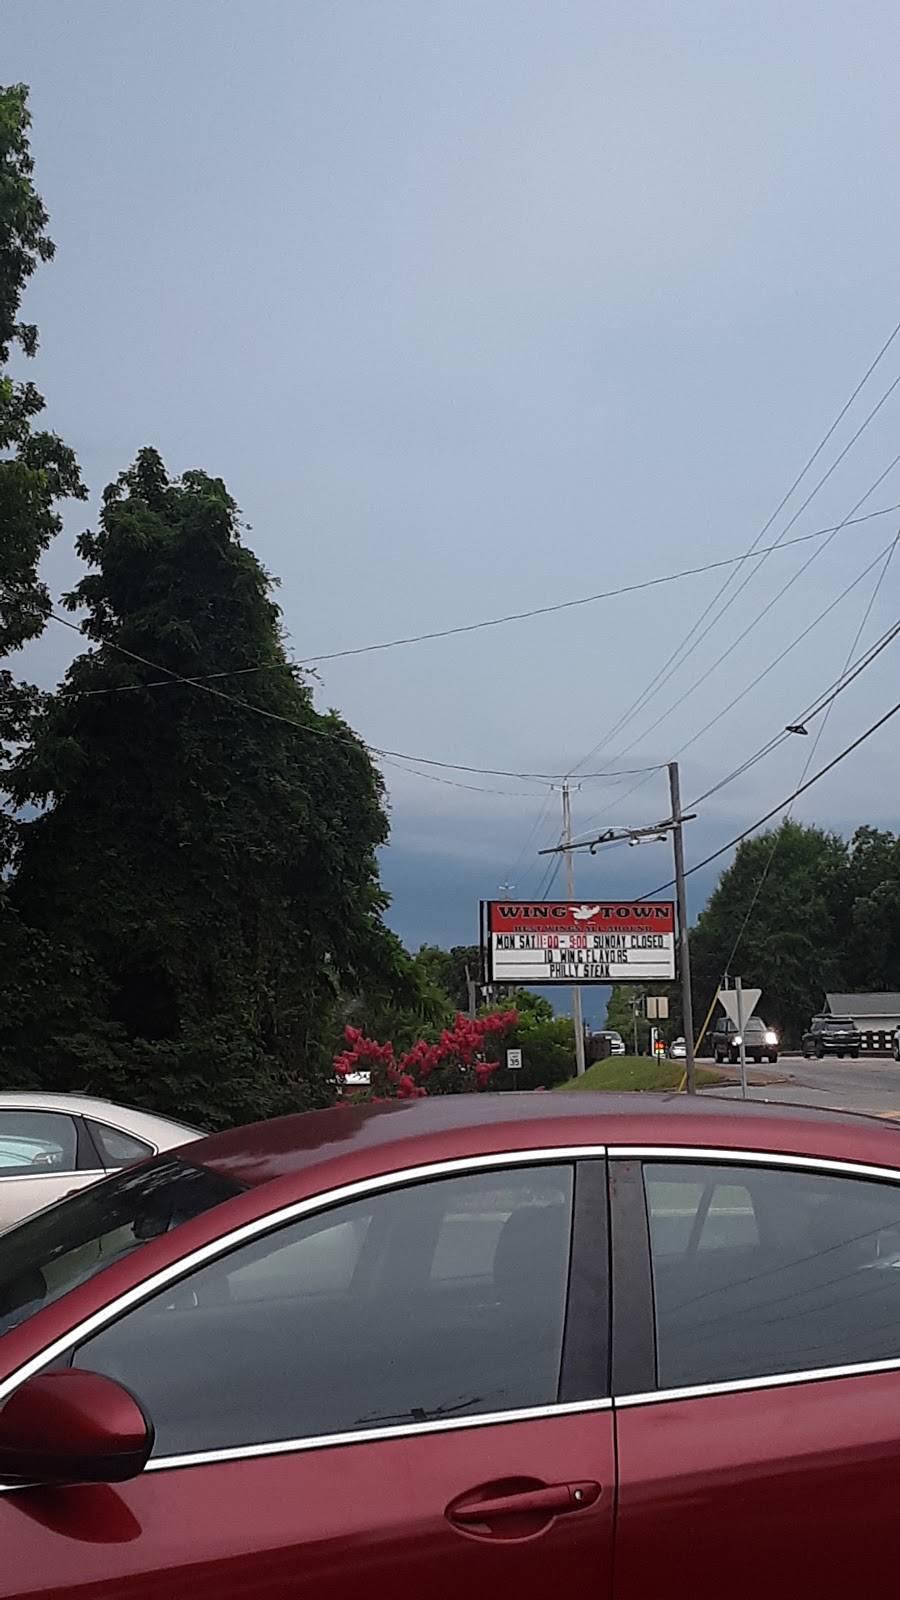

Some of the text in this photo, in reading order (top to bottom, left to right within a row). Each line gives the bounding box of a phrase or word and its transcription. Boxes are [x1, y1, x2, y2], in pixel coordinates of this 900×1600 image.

[498, 905, 670, 918] WING TOWN
[496, 935, 515, 949] MON
[569, 935, 587, 949] 9:00
[593, 935, 626, 949] SUNDAY
[631, 935, 664, 949] CLOSED
[544, 949, 628, 963] 10 WING FLAVORS
[550, 964, 610, 978] PHILLY STEAK
[510, 1058, 519, 1066] 35
